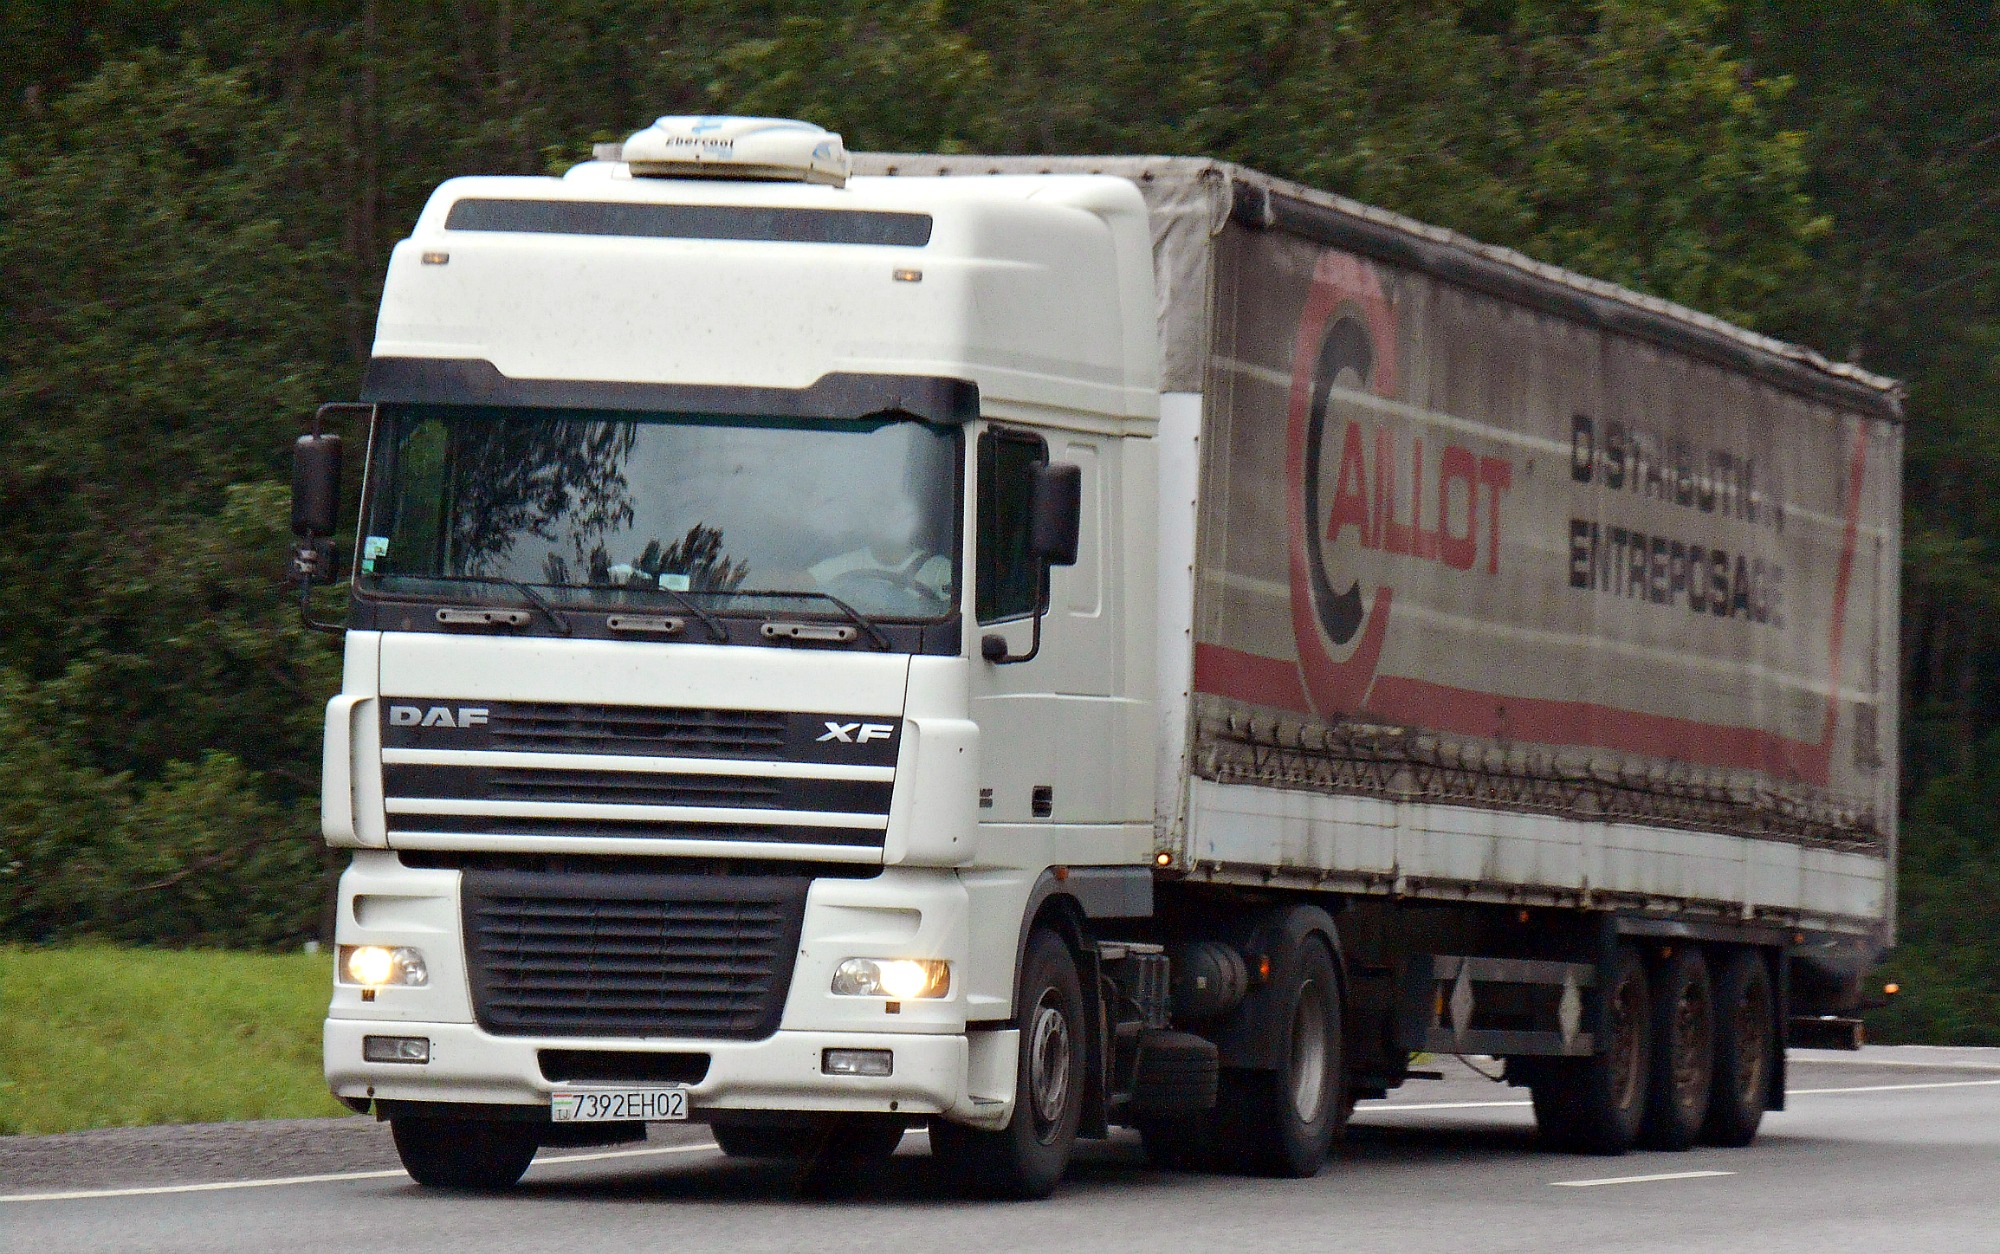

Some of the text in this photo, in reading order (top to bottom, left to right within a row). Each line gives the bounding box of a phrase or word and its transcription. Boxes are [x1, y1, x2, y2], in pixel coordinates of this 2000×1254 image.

[390, 706, 488, 728] DAF
[817, 721, 894, 743] XF
[573, 1093, 683, 1118] 7392EH02
